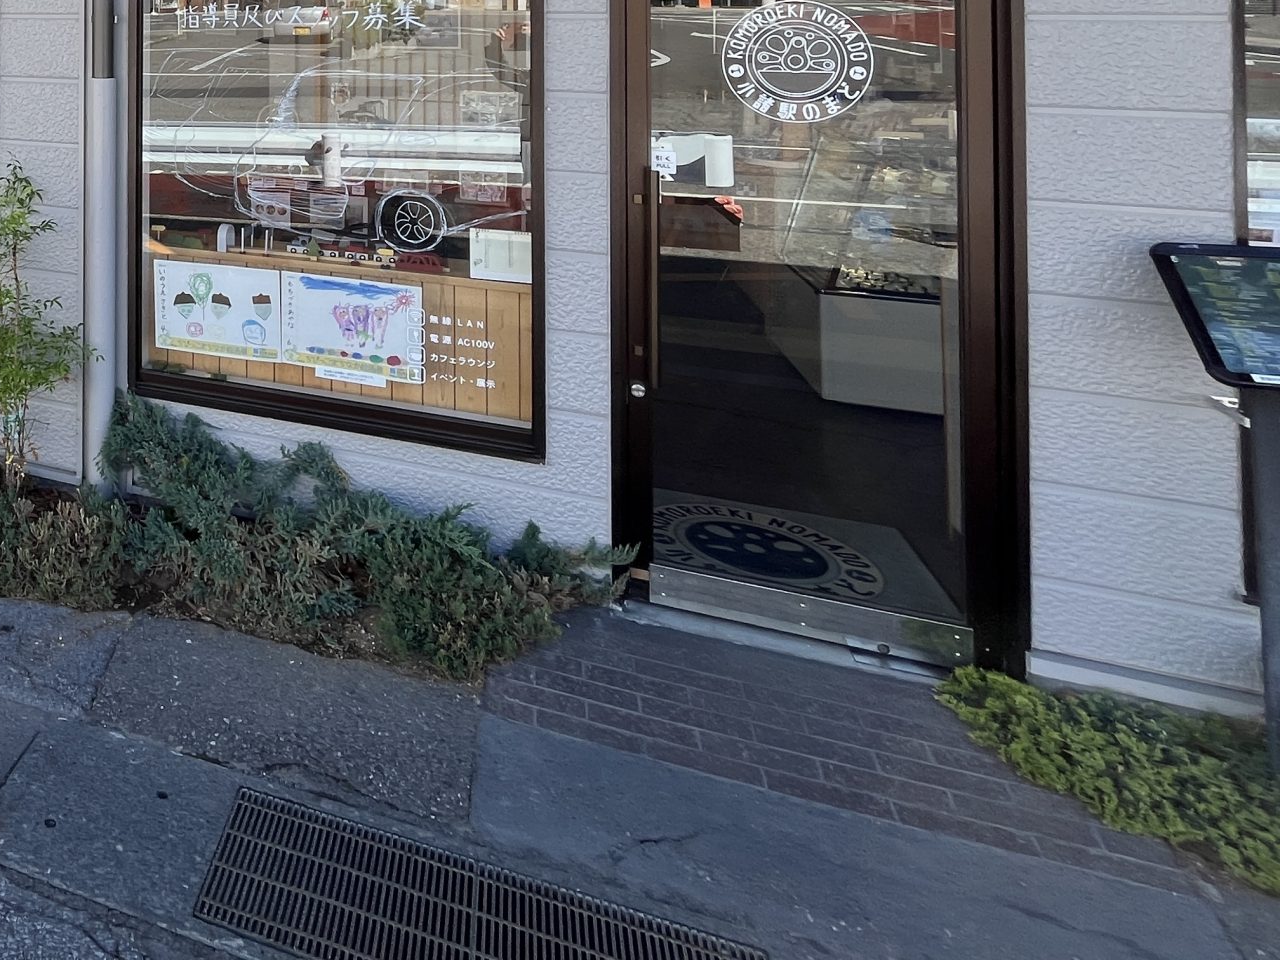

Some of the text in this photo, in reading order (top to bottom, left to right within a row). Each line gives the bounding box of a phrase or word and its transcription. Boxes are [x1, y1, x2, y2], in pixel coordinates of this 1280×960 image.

[727, 4, 868, 61] KOMOROEKI NOMADO
[457, 337, 495, 349] AC100V
[430, 353, 496, 369] カフェラウンジ
[768, 518, 871, 569] NOMADO
